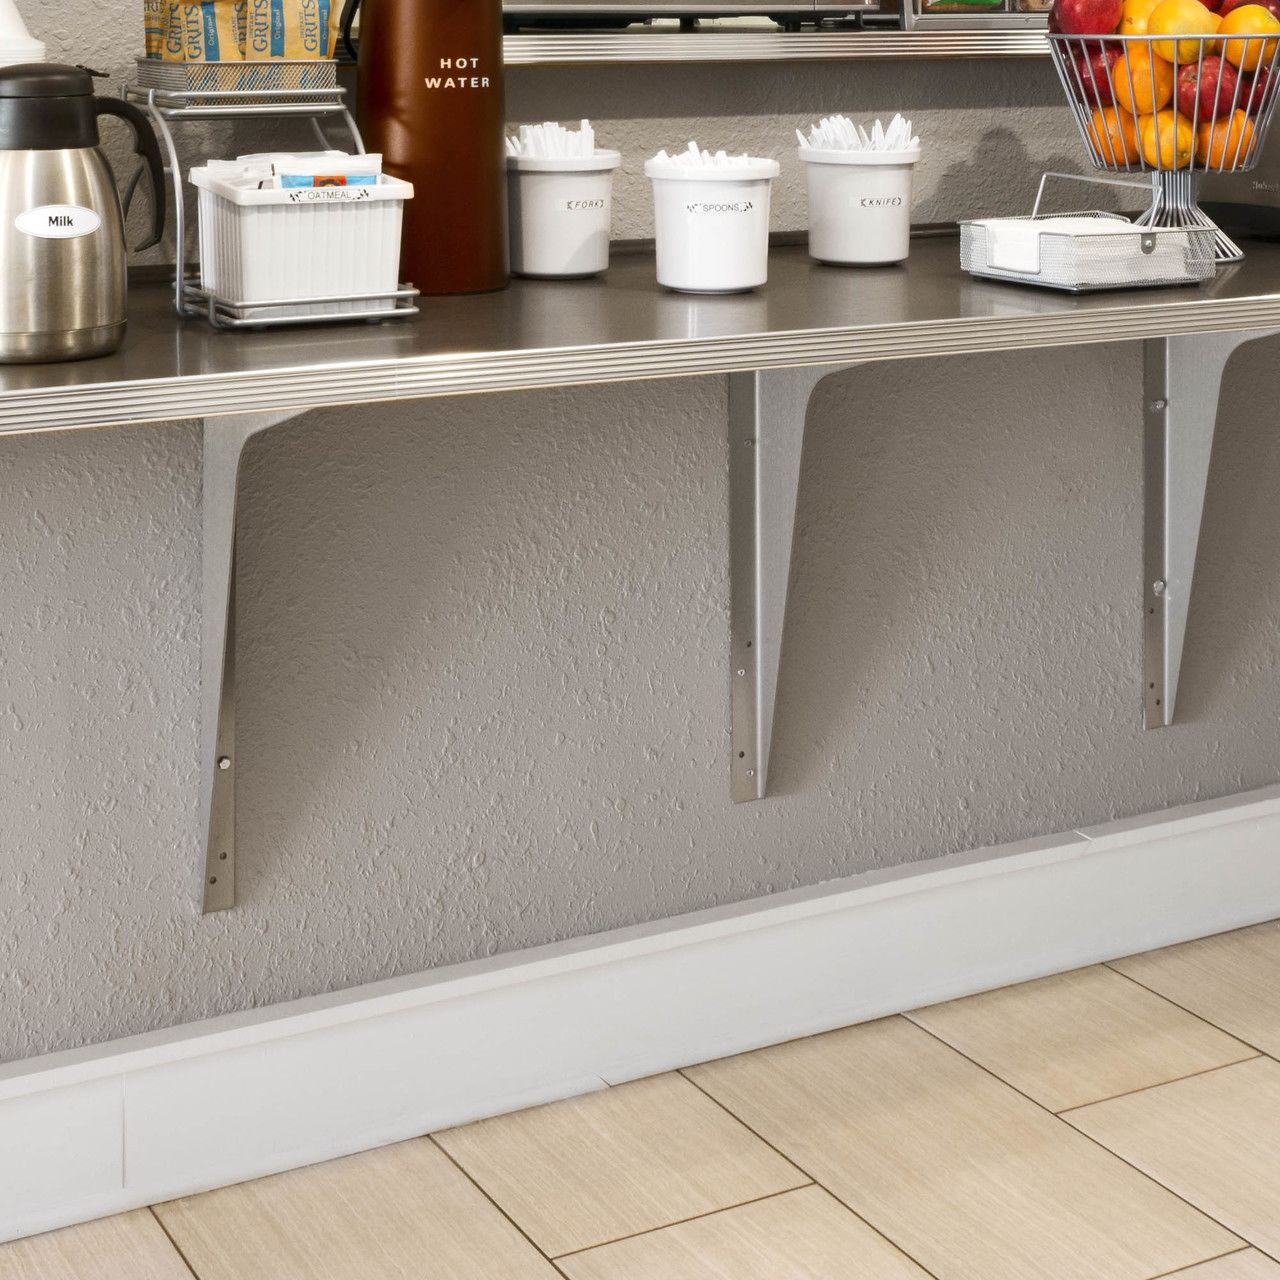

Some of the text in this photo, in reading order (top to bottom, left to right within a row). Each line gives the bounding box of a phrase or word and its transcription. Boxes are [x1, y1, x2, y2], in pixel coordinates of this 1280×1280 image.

[206, 15, 216, 46] Original
[273, 9, 281, 40] Original
[302, 0, 318, 52] GRITS
[184, 4, 202, 59] GRITS
[440, 57, 480, 69] HOT
[424, 77, 490, 89] WATER
[307, 191, 352, 200] OATMEAL
[869, 197, 897, 206] KNIFE
[574, 200, 599, 209] FORK
[702, 202, 740, 212] SPOONS
[48, 215, 74, 227] Milk
